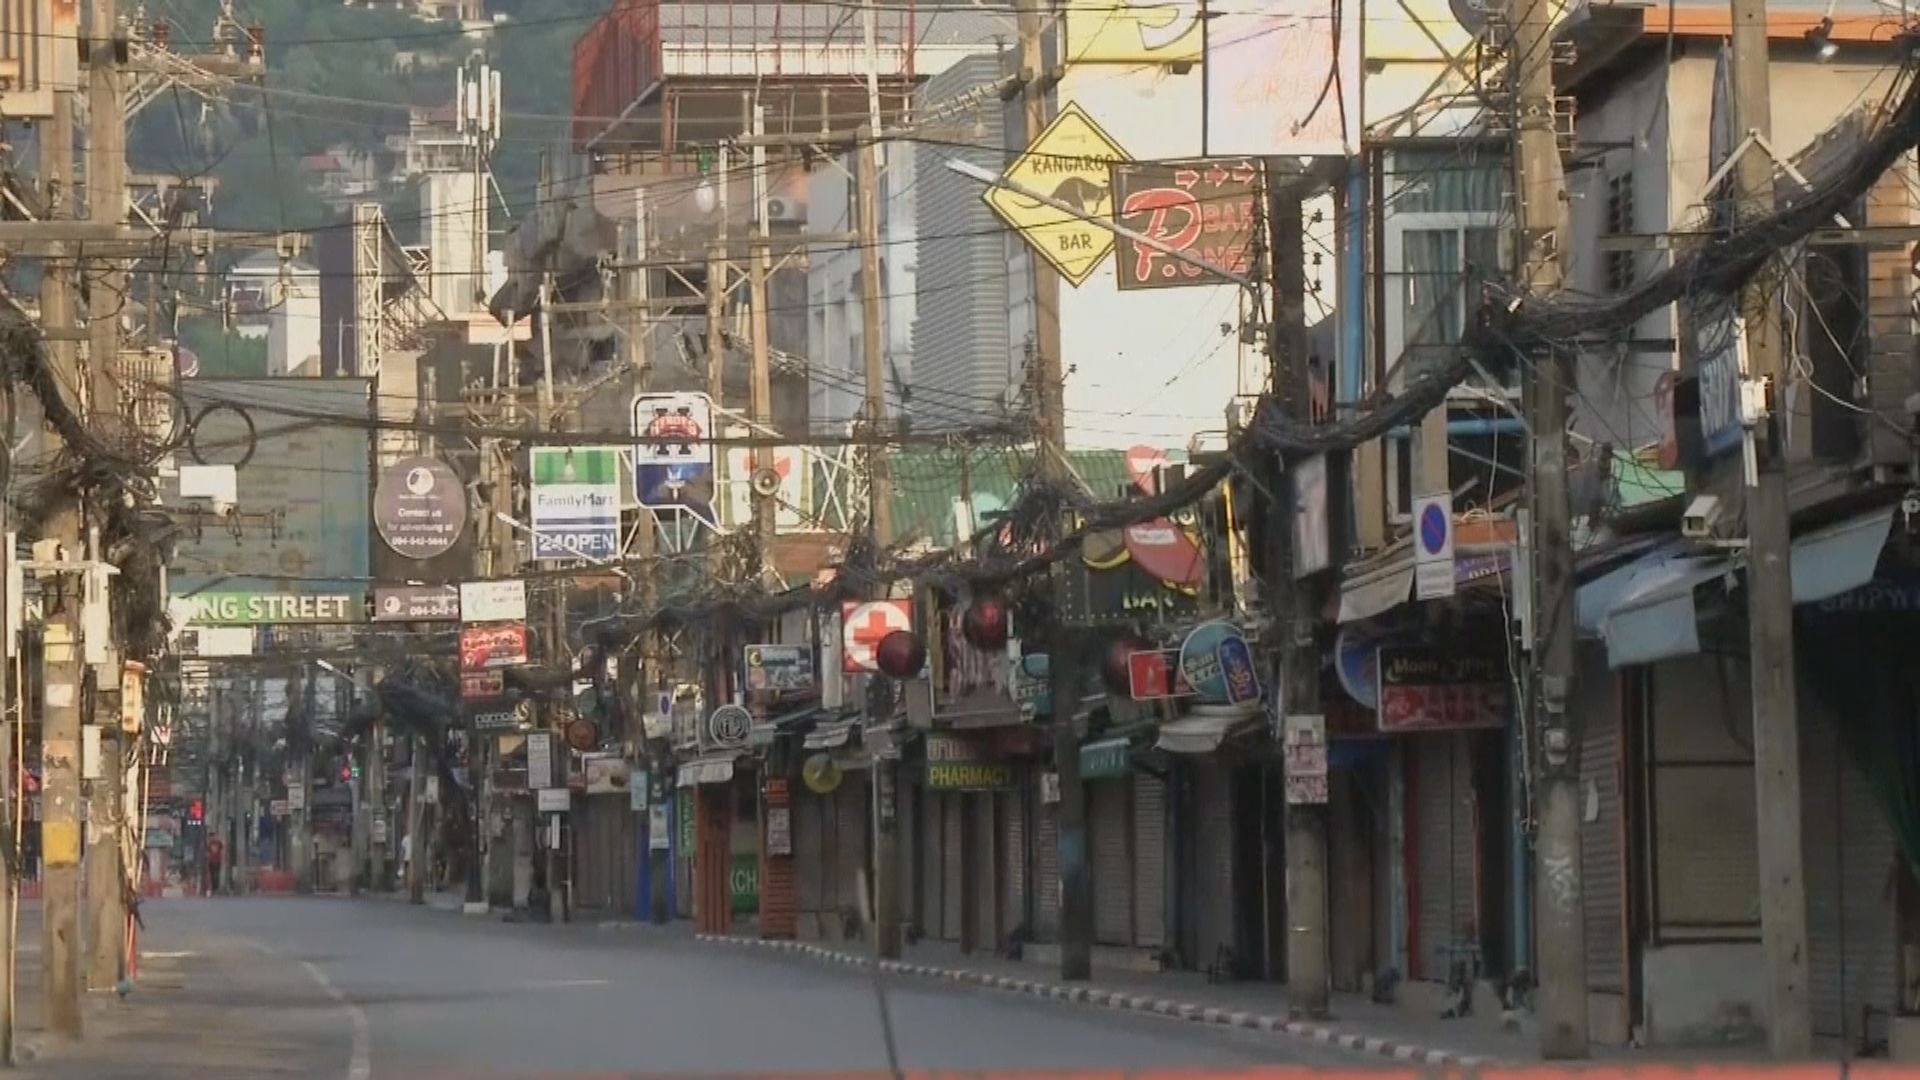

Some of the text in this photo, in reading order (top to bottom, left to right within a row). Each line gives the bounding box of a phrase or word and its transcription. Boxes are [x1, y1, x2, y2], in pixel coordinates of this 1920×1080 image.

[1059, 233, 1093, 250] BAR
[537, 493, 614, 506] FamilyMart
[249, 596, 349, 619] STREET
